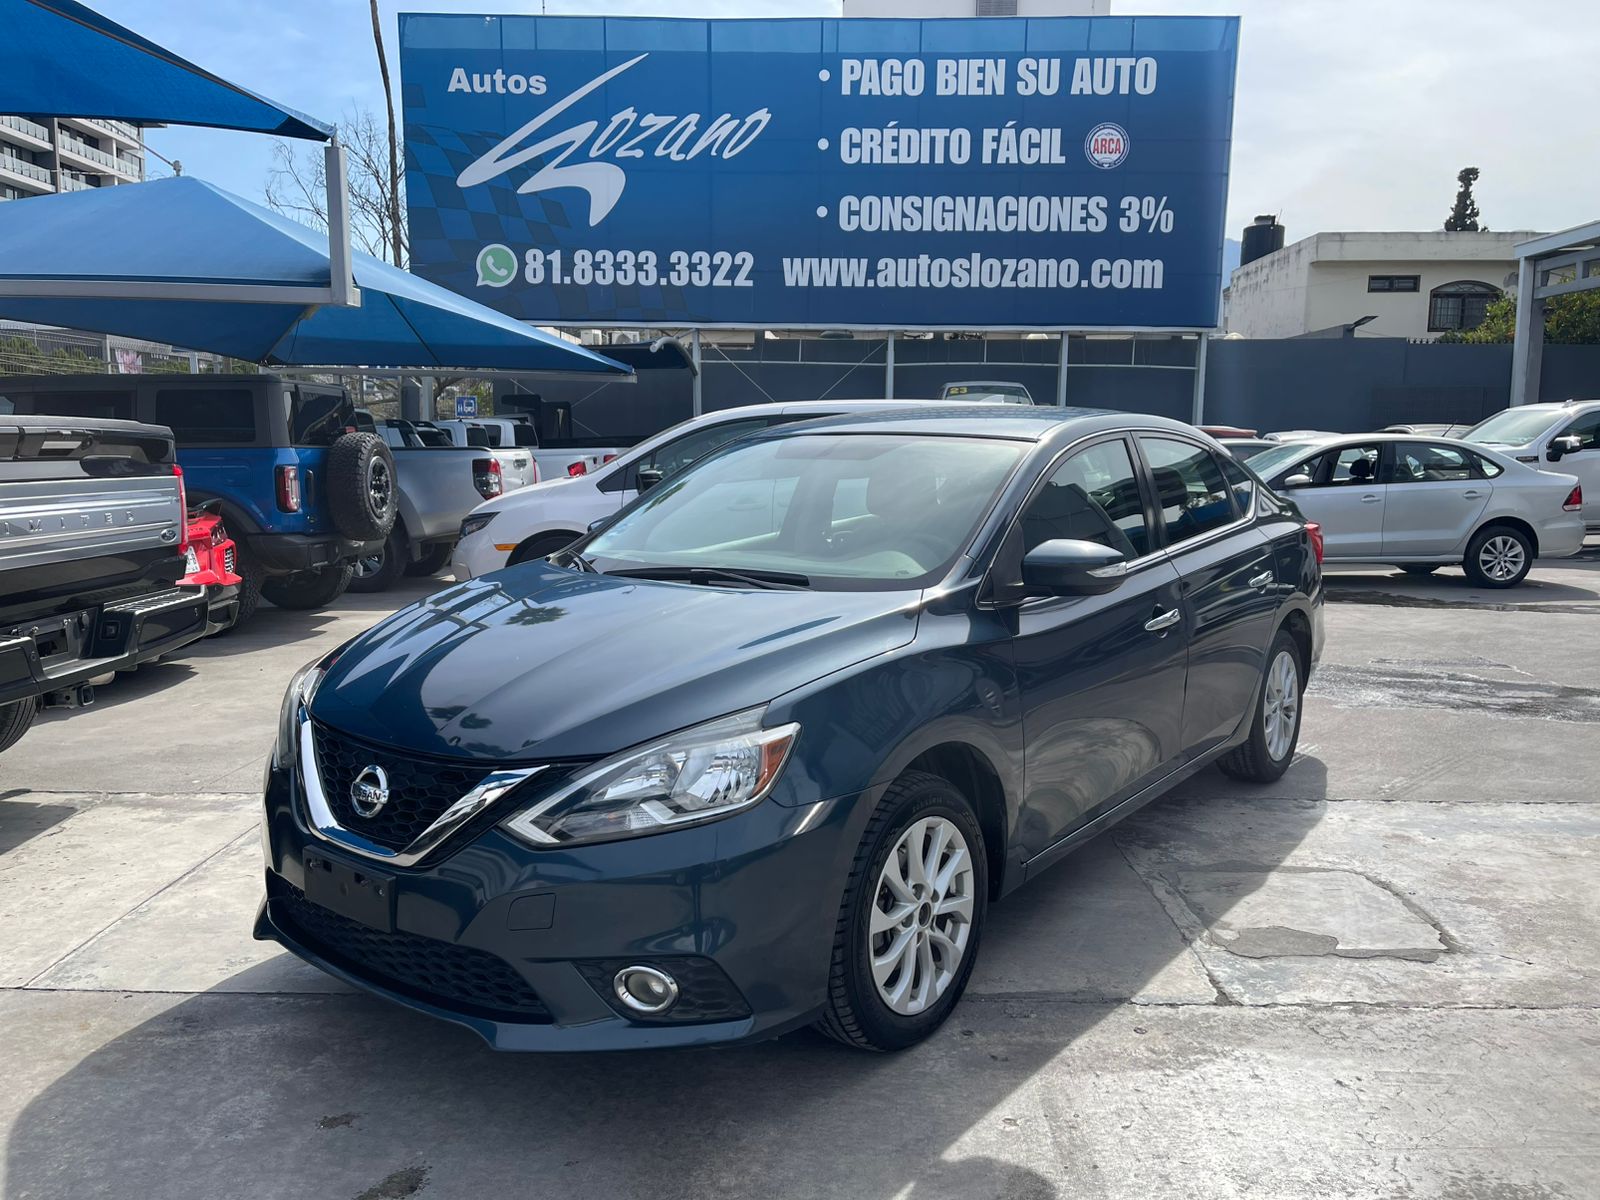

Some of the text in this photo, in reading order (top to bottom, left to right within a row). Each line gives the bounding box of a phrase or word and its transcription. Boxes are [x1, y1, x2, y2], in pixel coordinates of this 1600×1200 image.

[447, 68, 547, 95] Autos
[841, 56, 1158, 96] PAGO BIEN SU AUTO
[456, 52, 772, 227] Lozano
[840, 120, 1066, 165] CRÉDITO FÁCIL
[1092, 137, 1121, 154] ARCA
[839, 195, 1174, 234] CONSIGNACIONES 3%
[524, 248, 754, 287] 81.8333.3322
[782, 252, 1164, 289] www.autoslozano.com
